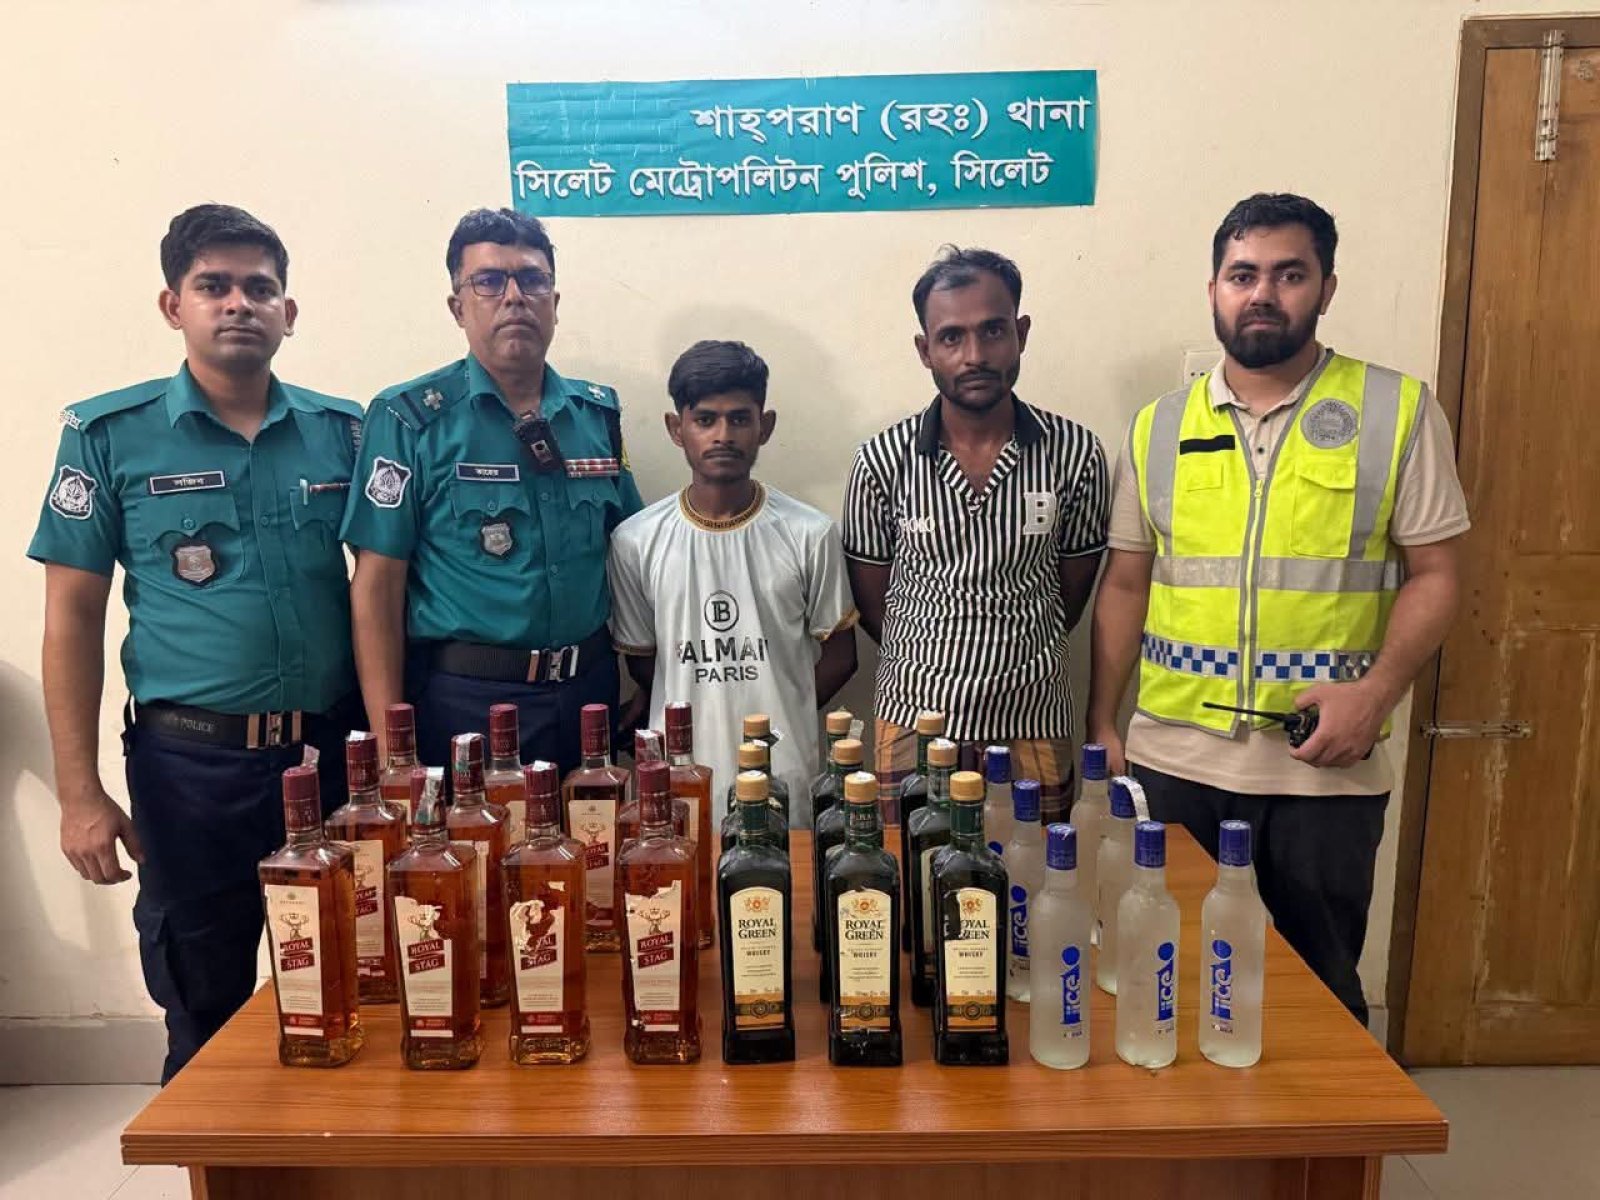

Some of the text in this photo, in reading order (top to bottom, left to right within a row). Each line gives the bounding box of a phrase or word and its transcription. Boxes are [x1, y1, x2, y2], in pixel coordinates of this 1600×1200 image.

[879, 97, 989, 142] (রহঃ)
[1006, 95, 1092, 132] থানা
[514, 148, 1054, 201] সিলেট মেট্রোপলিটন পুলিশ, সিলেট
[1023, 492, 1057, 535] B
[678, 637, 769, 664] ALMAI
[695, 665, 759, 684] PARIS
[738, 918, 777, 929] ROYAL
[845, 919, 884, 930] ROYAL
[959, 919, 990, 929] OYAL
[738, 928, 776, 940] GREEN
[844, 929, 884, 941] GREEN
[415, 958, 440, 971] STAG
[643, 950, 668, 966] STAG
